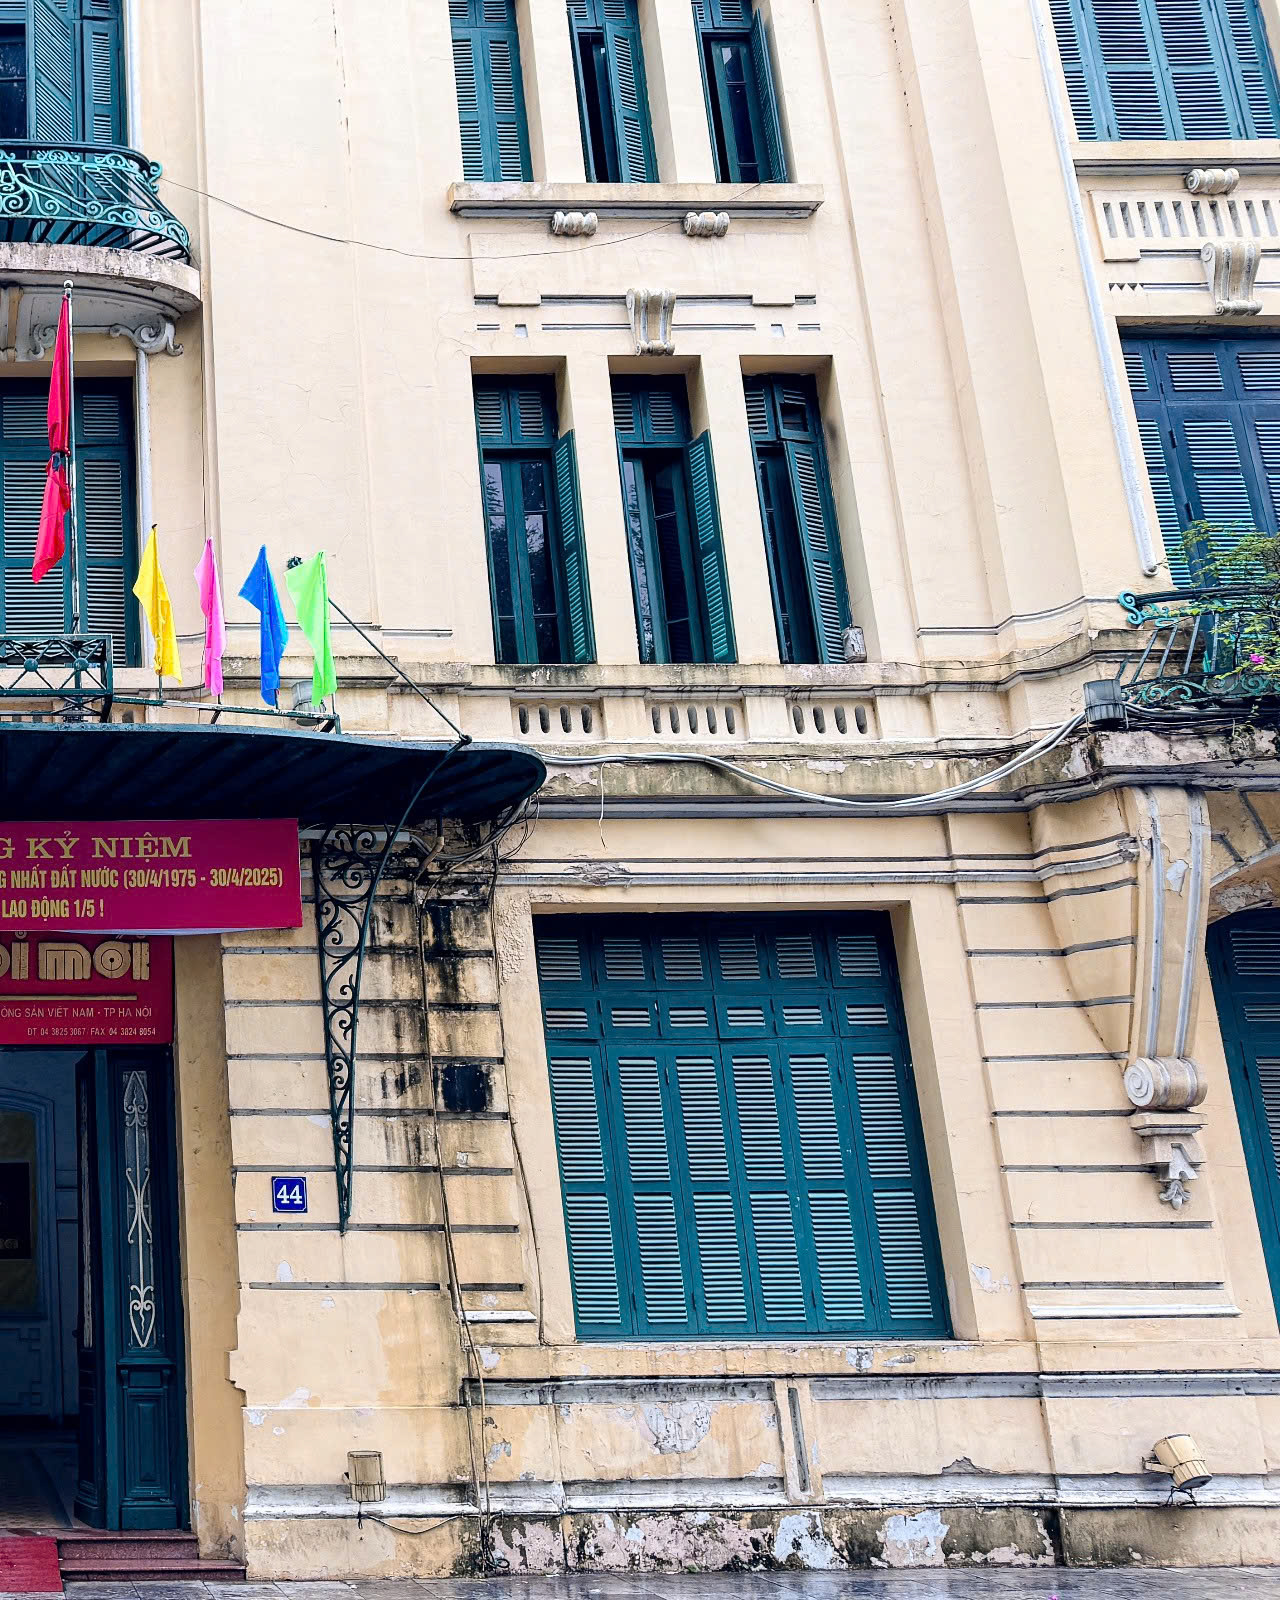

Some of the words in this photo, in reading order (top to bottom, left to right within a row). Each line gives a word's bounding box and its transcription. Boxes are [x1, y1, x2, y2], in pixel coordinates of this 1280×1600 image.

[25, 830, 80, 859] KỶ
[91, 832, 193, 862] NIỆM
[10, 864, 46, 888] NHẤT
[50, 864, 77, 888] ĐẤT
[81, 865, 119, 888] NƯỚC
[123, 868, 196, 889] (30/4/1975
[210, 867, 283, 887] 30/4/2025)
[2, 899, 27, 918] LAO
[31, 895, 69, 921] ĐỘNG
[73, 898, 95, 918] 1/5
[100, 898, 104, 918] !
[72, 1007, 94, 1018] NAM
[104, 1007, 116, 1018] TP
[91, 1027, 105, 1036] FAX
[277, 1185, 303, 1204] 44
